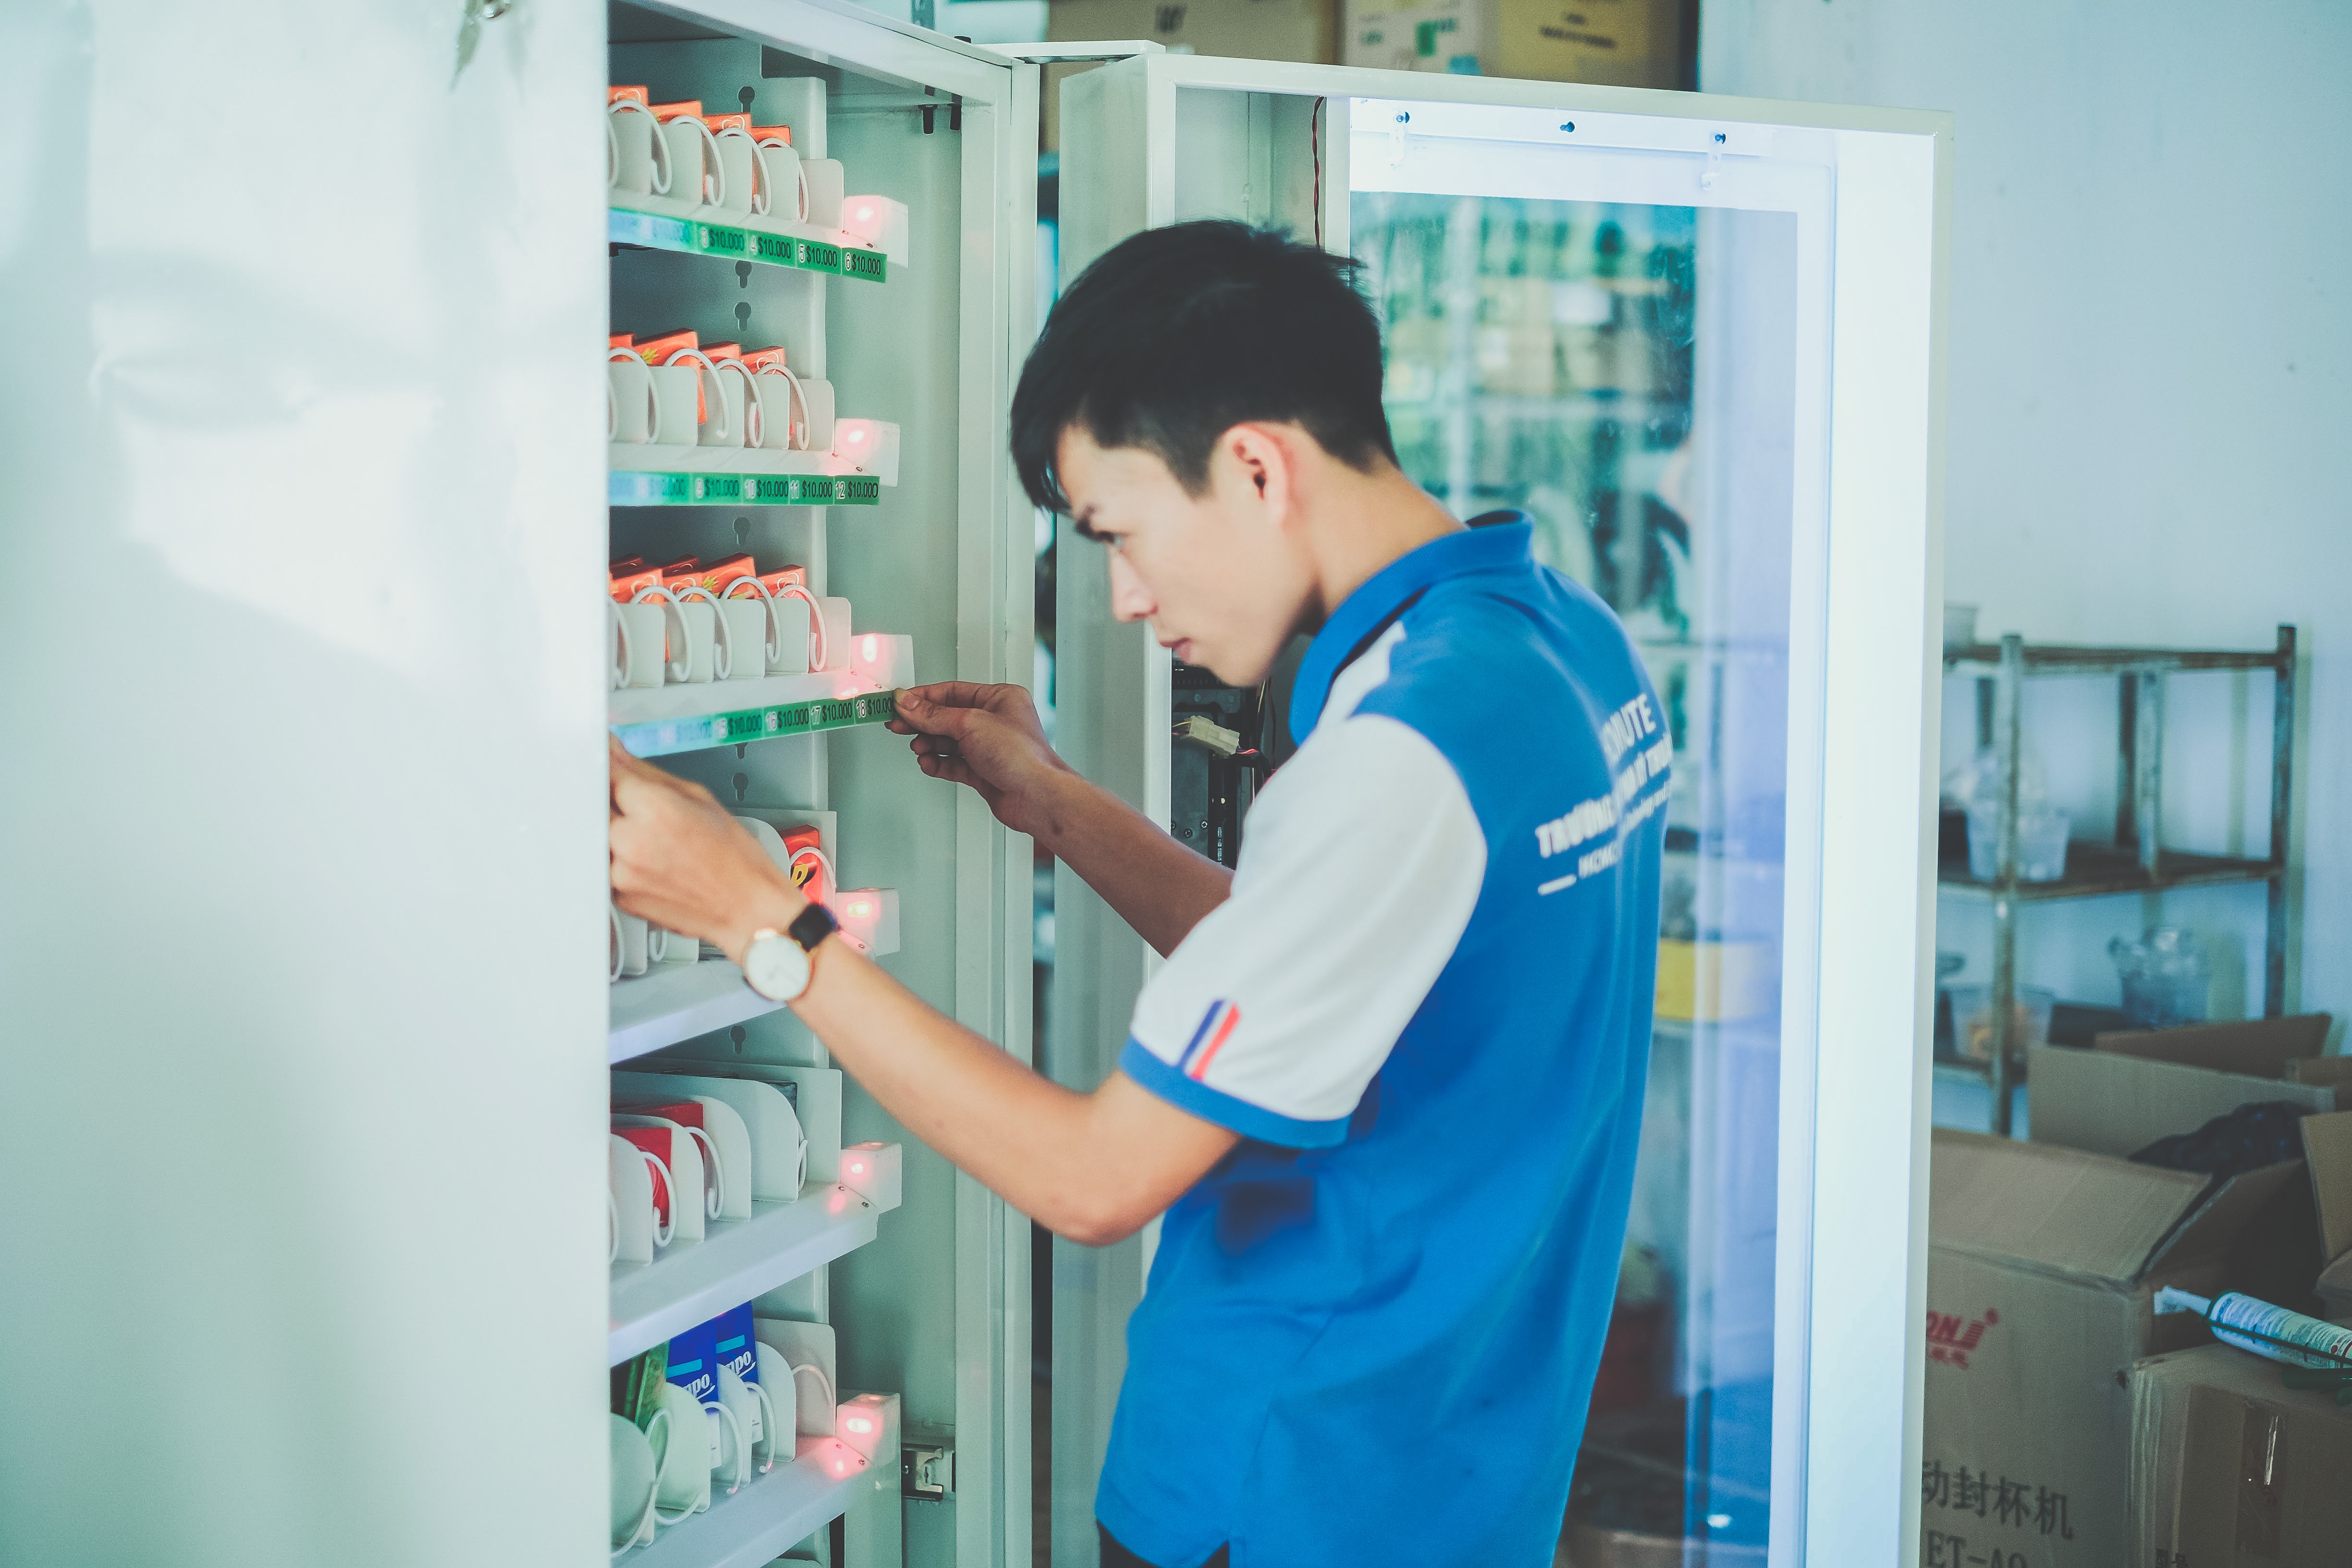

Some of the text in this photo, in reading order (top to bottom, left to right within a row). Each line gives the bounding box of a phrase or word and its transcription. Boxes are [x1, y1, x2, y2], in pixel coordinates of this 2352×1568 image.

[710, 228, 745, 251] $10.000
[758, 236, 791, 258] $10.000
[799, 244, 837, 267] 5 $10.000
[845, 252, 881, 275] 6 $10.000
[757, 479, 789, 498] $10.000
[802, 480, 833, 498] $10.000
[836, 481, 879, 500] 12 $10.000
[811, 702, 853, 725] 17 $10.000
[857, 697, 894, 718] 18 $10.00
[777, 708, 809, 729] $10.000
